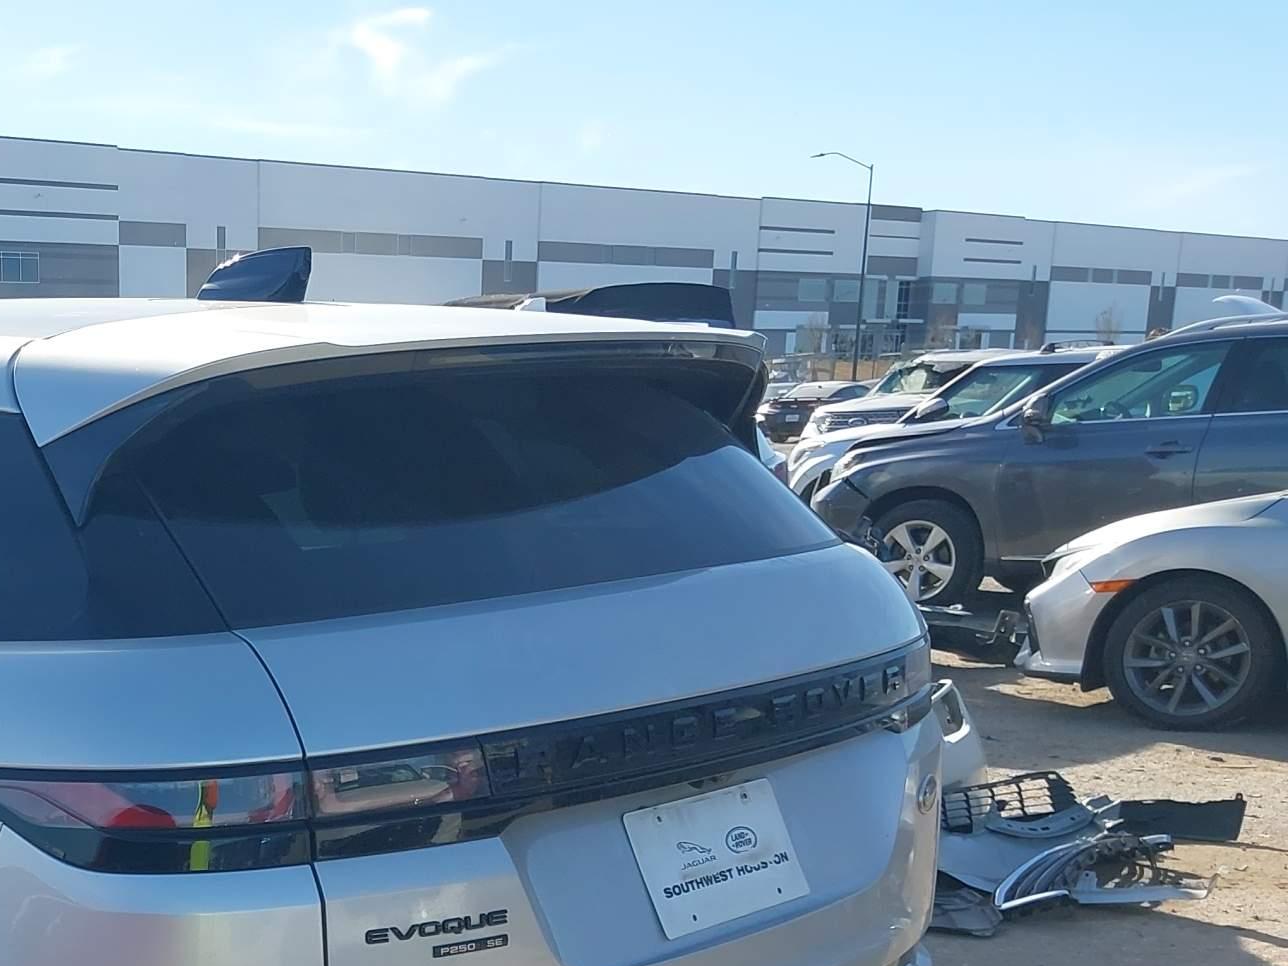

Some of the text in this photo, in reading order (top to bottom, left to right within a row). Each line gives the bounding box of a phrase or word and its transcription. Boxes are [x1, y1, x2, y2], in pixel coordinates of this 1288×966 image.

[663, 851, 789, 898] SOUTHWEST HOUSON
[681, 855, 717, 870] JAGUAR
[365, 909, 508, 944] EVOQUE
[441, 937, 503, 956] P250 SE
